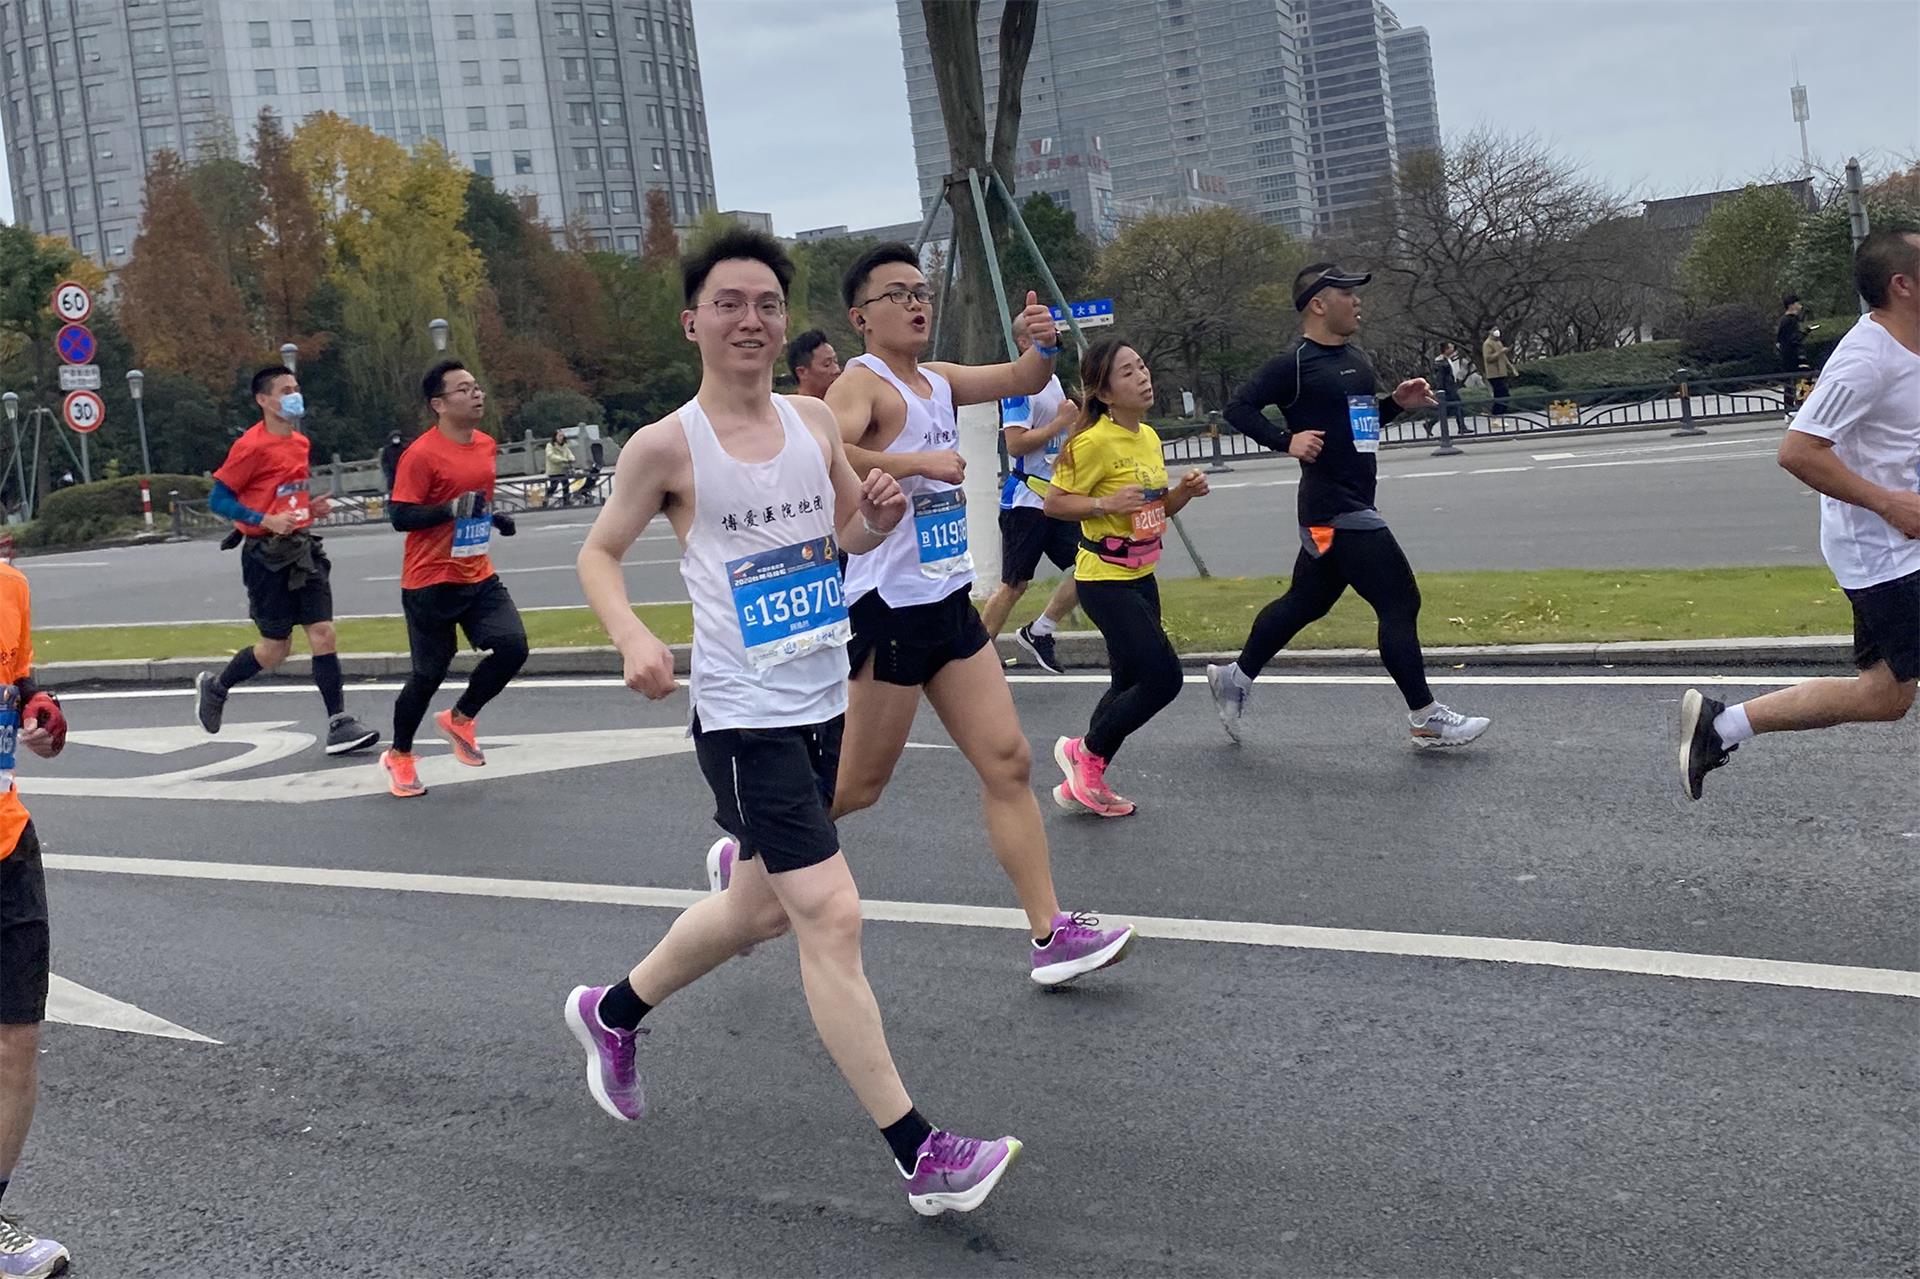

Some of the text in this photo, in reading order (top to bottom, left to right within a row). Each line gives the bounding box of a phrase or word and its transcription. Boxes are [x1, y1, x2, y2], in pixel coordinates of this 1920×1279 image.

[62, 292, 84, 311] 60
[73, 402, 93, 420] 30
[721, 495, 823, 531] 博爱医院跑团
[921, 531, 931, 548] B
[743, 605, 758, 627] C
[756, 576, 841, 626] 13870
